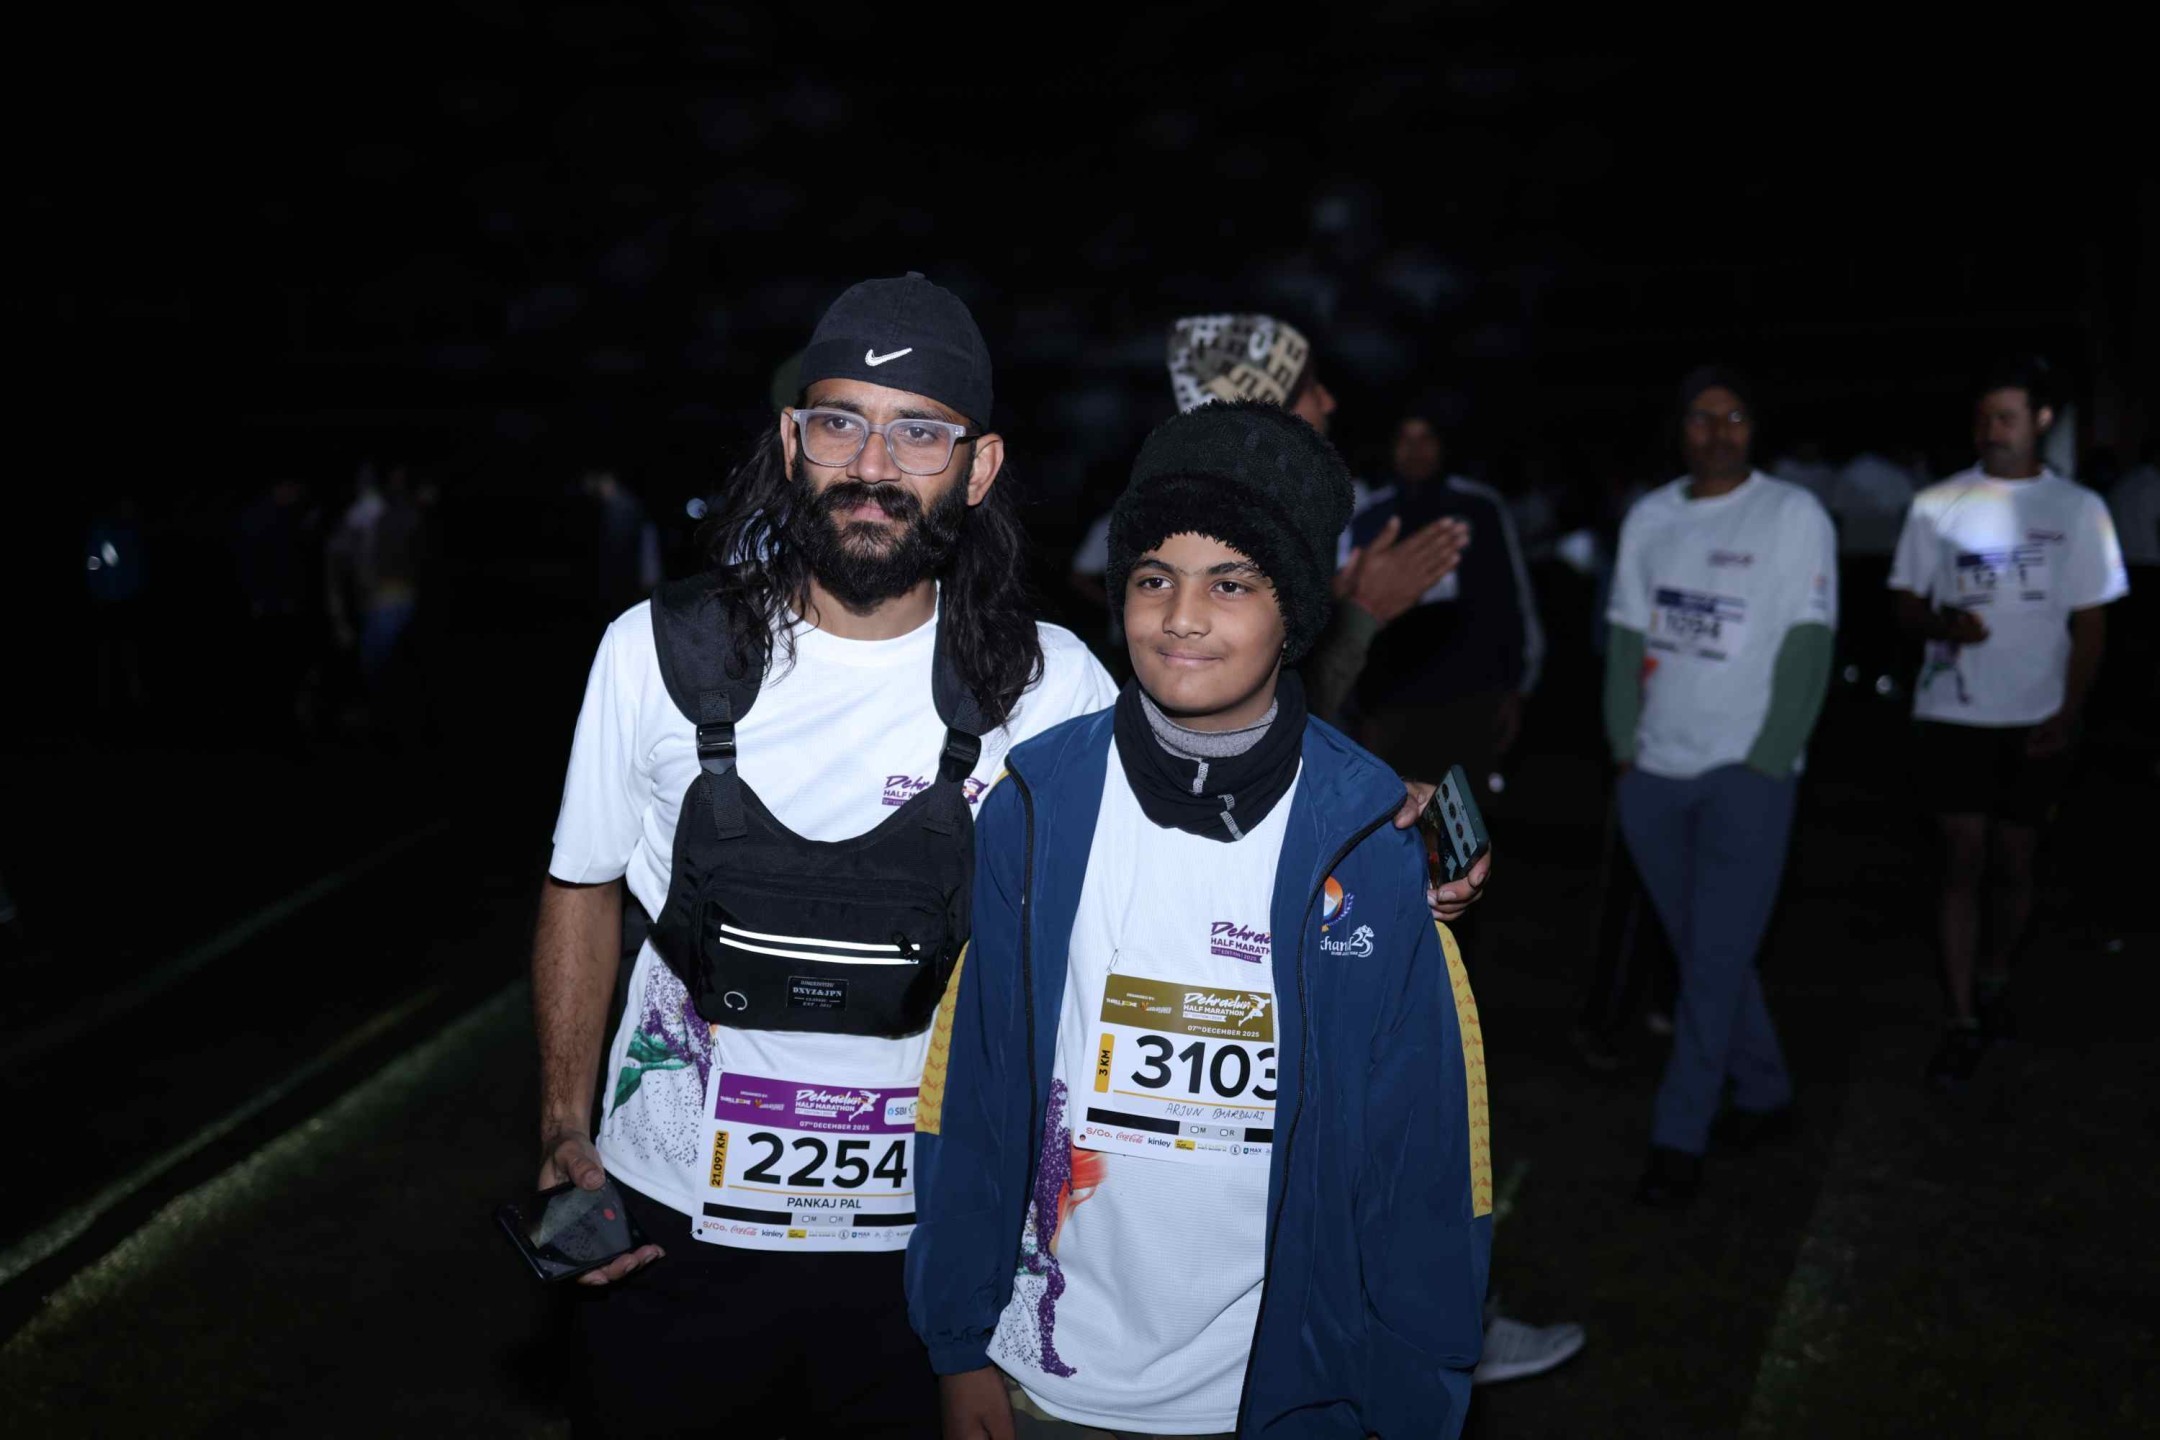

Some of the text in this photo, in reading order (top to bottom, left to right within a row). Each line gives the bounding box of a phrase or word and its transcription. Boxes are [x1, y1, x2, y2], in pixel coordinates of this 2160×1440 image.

[1211, 937, 1234, 947] HALF
[1184, 992, 1251, 1010] Dehradun
[1183, 1004, 1245, 1016] HALF MARATHON
[1202, 1026, 1241, 1036] DECEMBER
[1100, 1050, 1111, 1066] KM
[1131, 1034, 1277, 1101] 3103
[796, 1089, 862, 1106] Dehradun
[795, 1101, 815, 1109] HALF
[815, 1103, 855, 1112] MARATHON
[894, 1107, 907, 1116] SBI
[1165, 1102, 1205, 1117] ARJUN
[813, 1122, 852, 1130] DECEMBER
[1148, 1137, 1171, 1148] kinley
[711, 1132, 727, 1187] 21.097 KM
[743, 1131, 908, 1189] 2254
[787, 1197, 862, 1209] PANKAJ PAL
[761, 1229, 784, 1238] kinley
